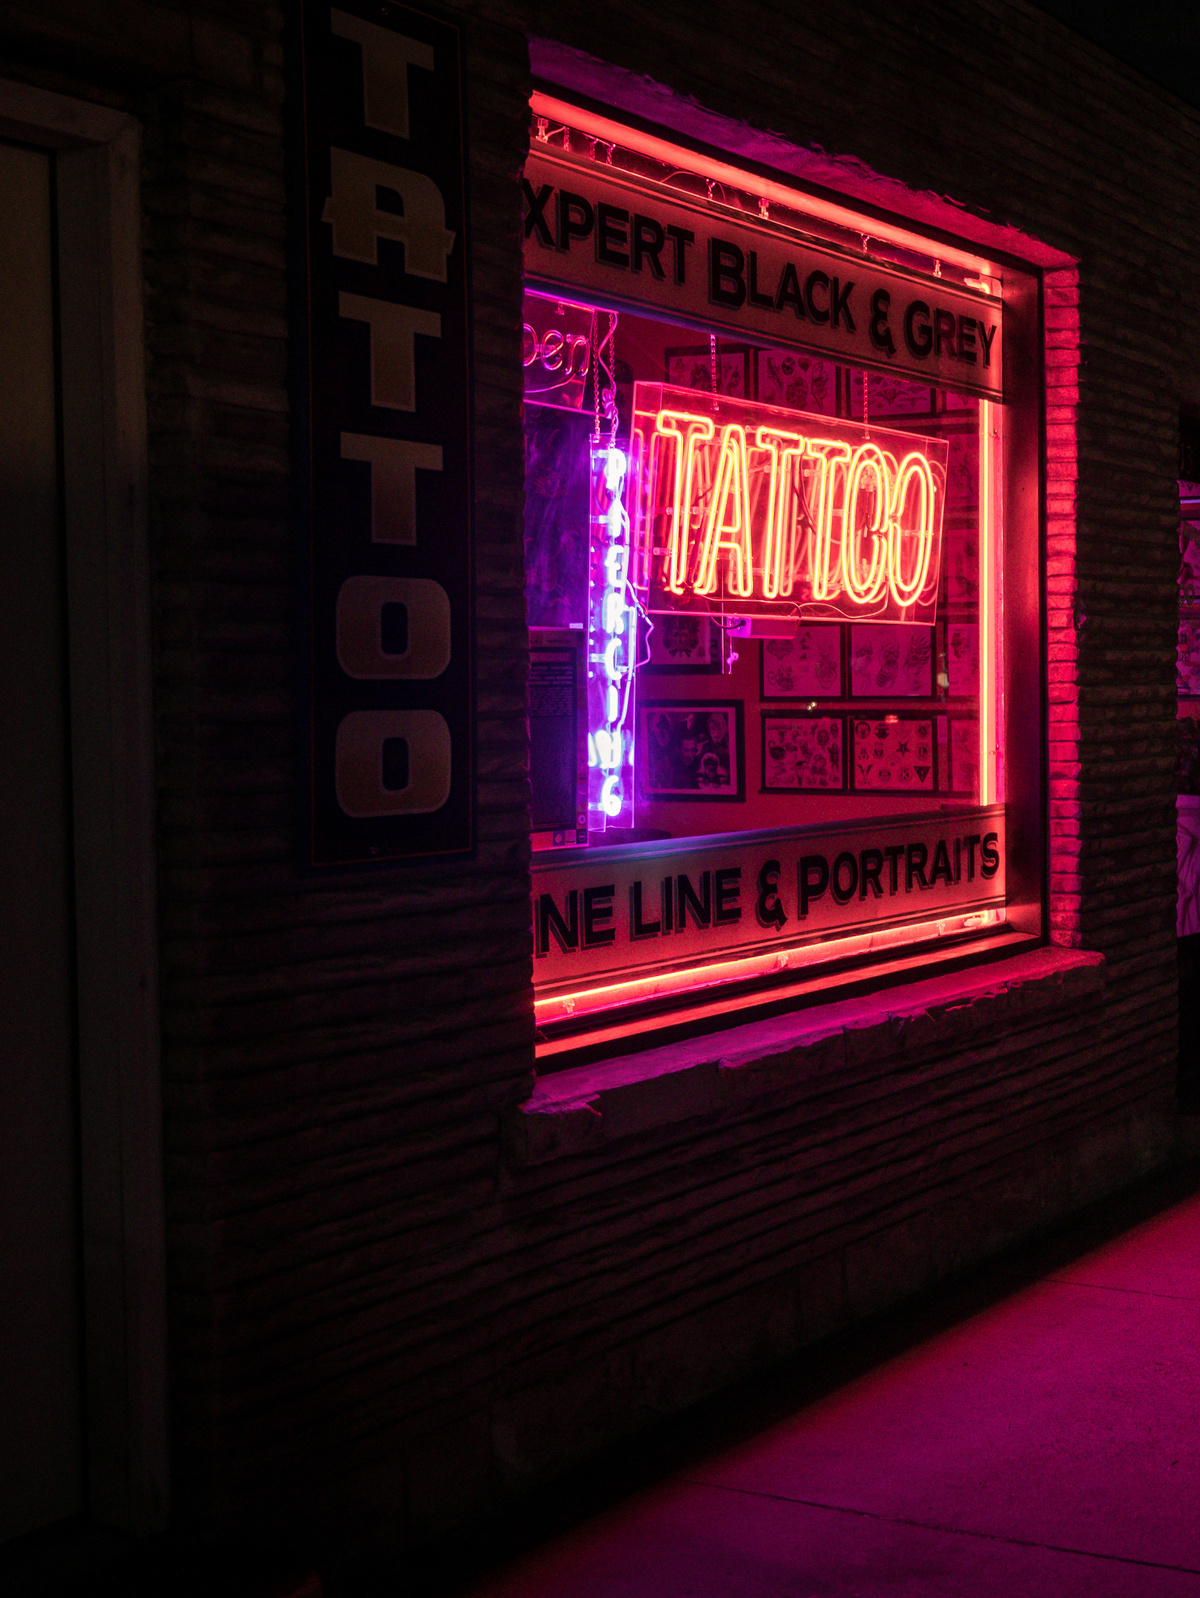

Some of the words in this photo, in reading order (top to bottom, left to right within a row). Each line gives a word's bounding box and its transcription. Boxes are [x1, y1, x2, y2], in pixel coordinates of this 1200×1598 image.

[707, 238, 857, 332] BLACK
[869, 288, 897, 356] &
[903, 299, 997, 369] GREY
[321, 7, 457, 819] TATTOO
[657, 409, 933, 606] TATTOO
[629, 866, 743, 942] LINE
[755, 859, 789, 932] &
[797, 833, 999, 920] PORTRAITS
